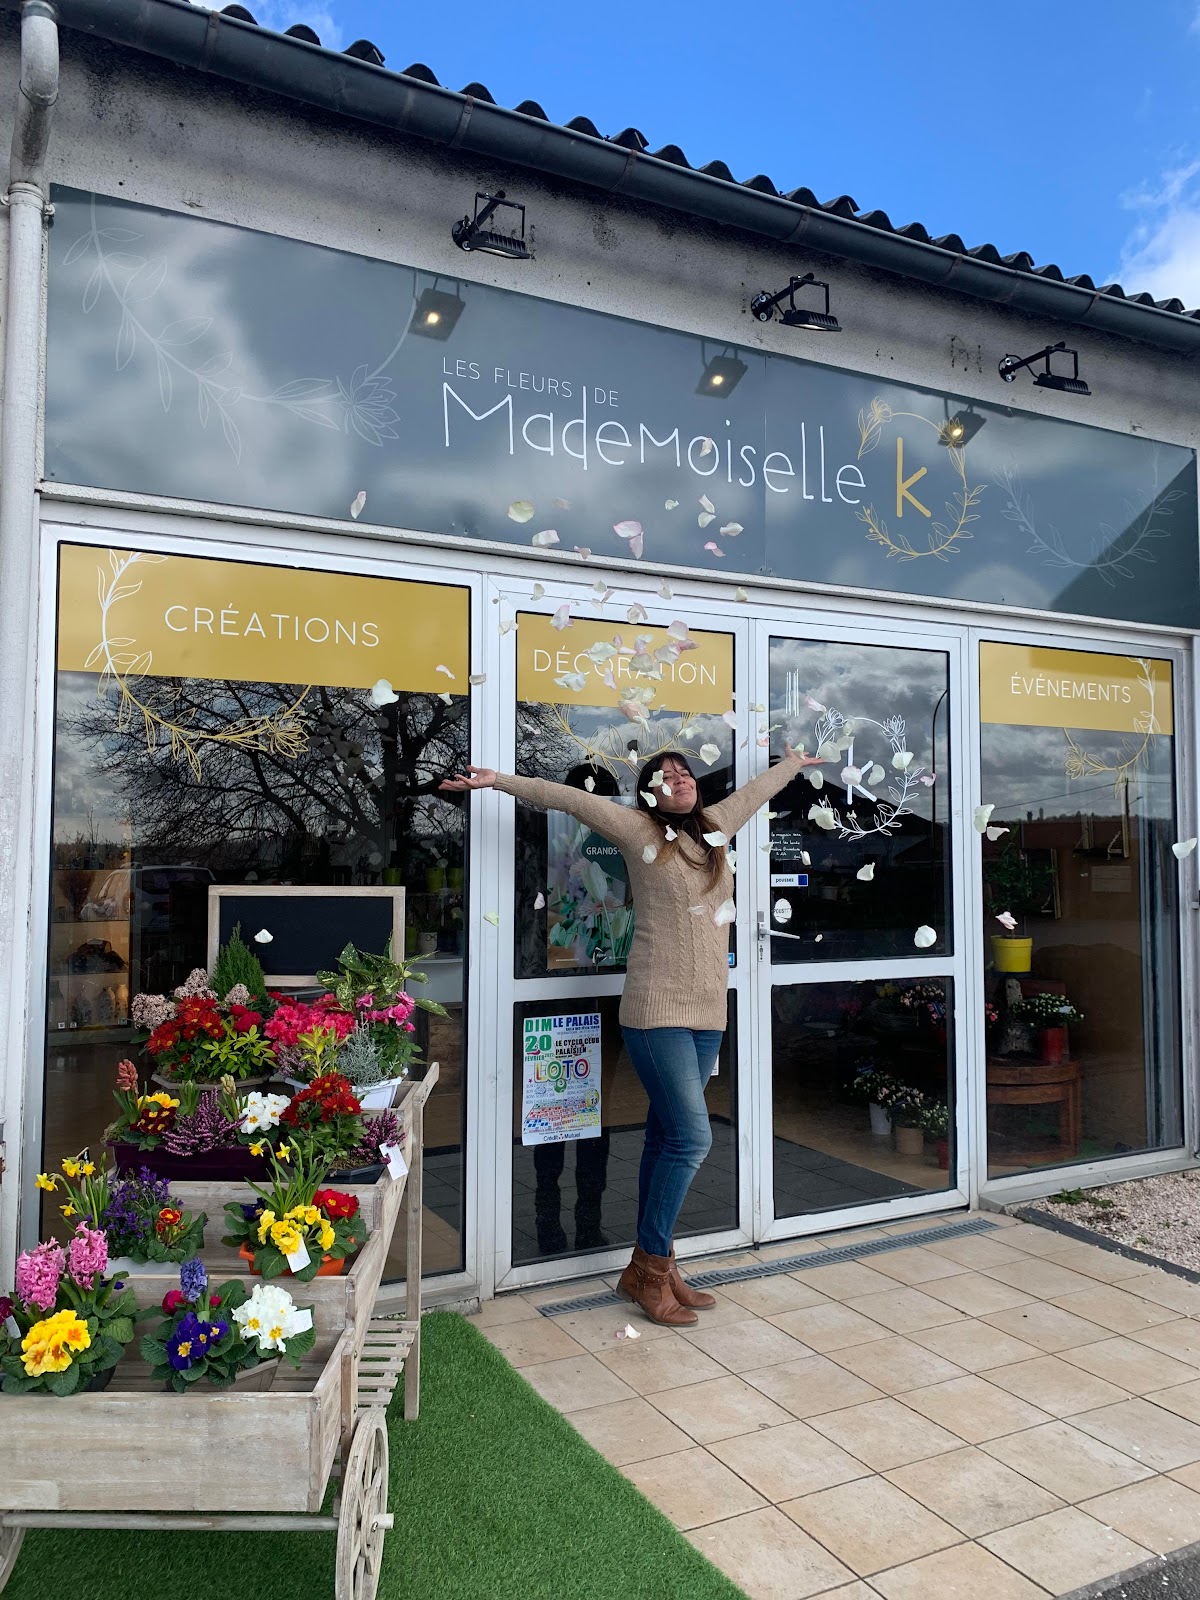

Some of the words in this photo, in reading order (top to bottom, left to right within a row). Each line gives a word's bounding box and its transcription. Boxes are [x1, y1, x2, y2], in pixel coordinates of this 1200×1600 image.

[442, 356, 481, 381] LES
[493, 367, 573, 398] FLEURS
[594, 387, 619, 408] DE
[164, 603, 381, 648] CRÉATIONS
[1011, 671, 1132, 704] ÉVÉNEMENTS
[586, 846, 624, 856] GRANDS-
[525, 1018, 552, 1032] DIM
[553, 1017, 563, 1028] LE
[566, 1015, 600, 1027] PALAIS
[525, 1034, 552, 1052] 20
[563, 1038, 583, 1046] CYCLO
[584, 1037, 600, 1045] CLUB
[555, 1046, 587, 1056] PALAISIEN
[535, 1058, 589, 1081] LOTO
